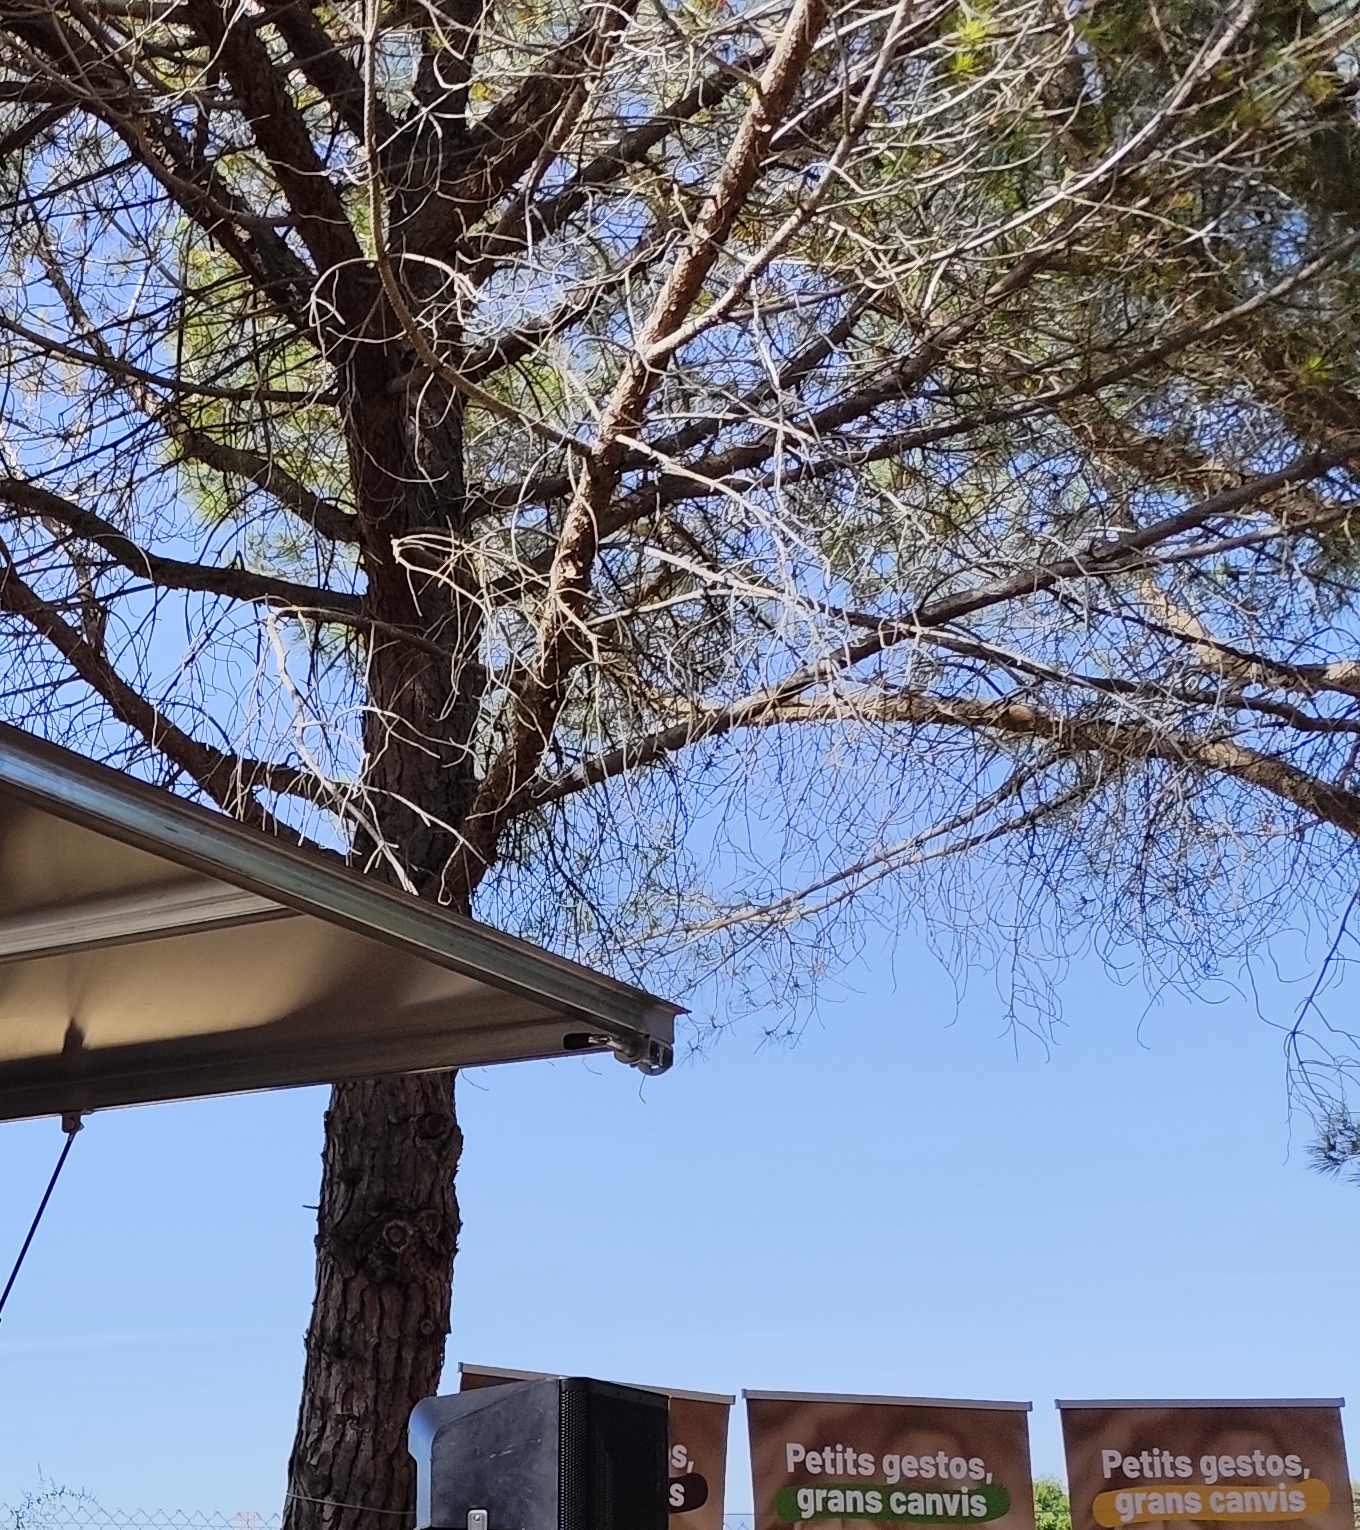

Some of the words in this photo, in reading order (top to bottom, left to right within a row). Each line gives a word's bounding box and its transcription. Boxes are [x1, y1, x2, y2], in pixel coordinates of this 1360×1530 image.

[785, 1443, 876, 1476] Petits
[882, 1451, 993, 1485] gestos,
[1101, 1448, 1194, 1480] Petits
[1199, 1450, 1311, 1484] gestos,
[796, 1487, 883, 1519] grans
[889, 1486, 988, 1517] canvis
[1114, 1489, 1203, 1522] grans
[1209, 1483, 1307, 1514] canvis
